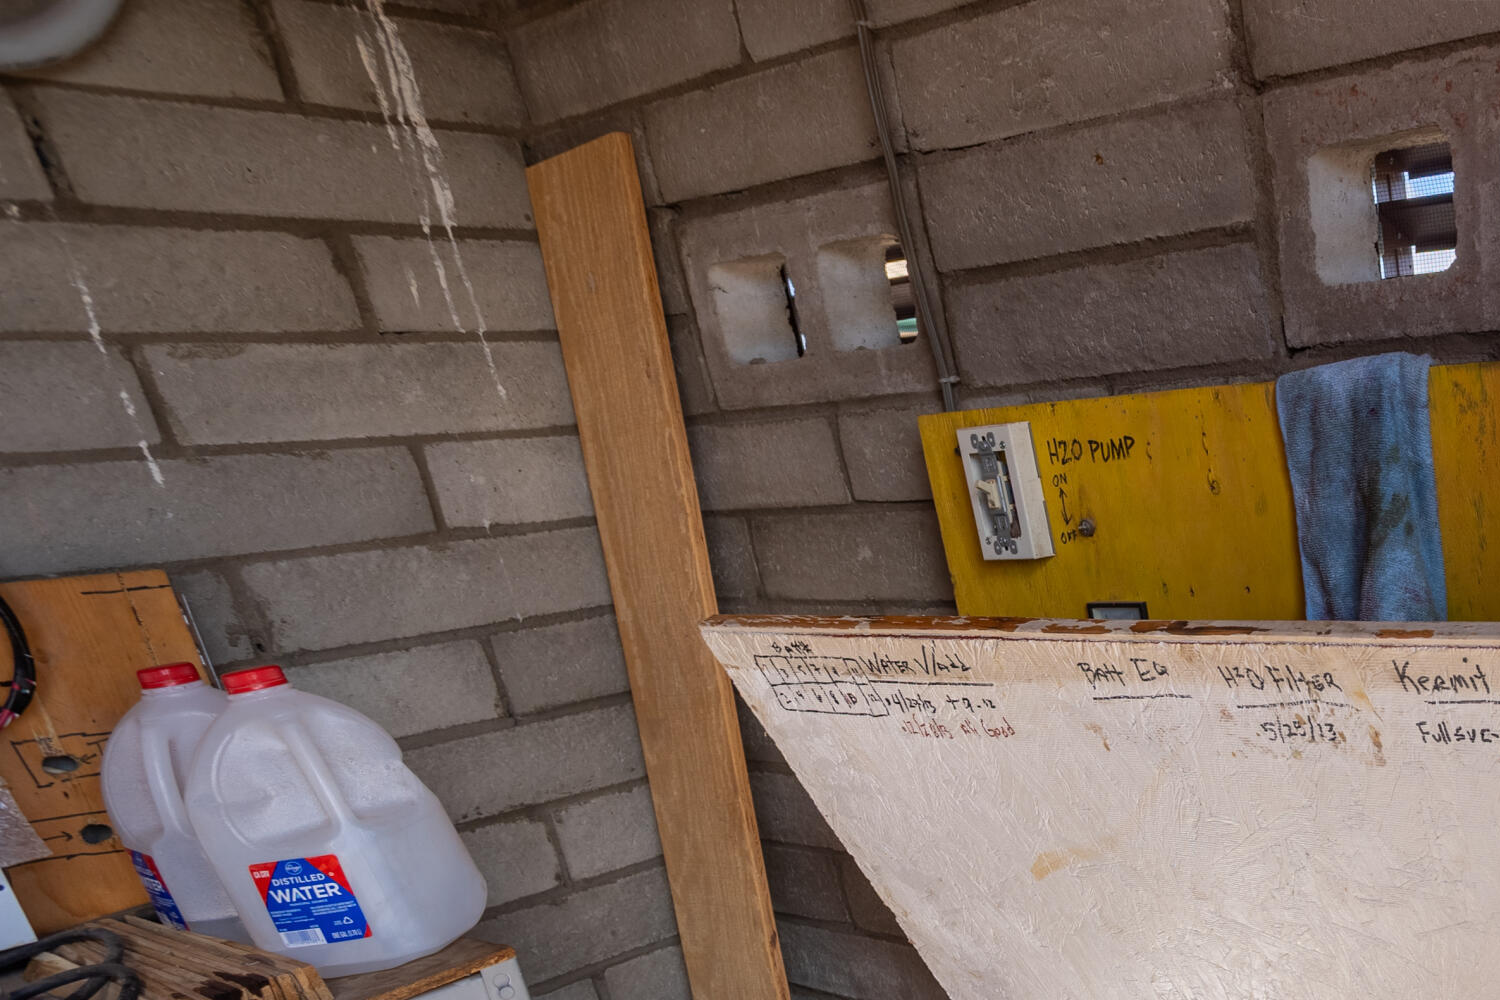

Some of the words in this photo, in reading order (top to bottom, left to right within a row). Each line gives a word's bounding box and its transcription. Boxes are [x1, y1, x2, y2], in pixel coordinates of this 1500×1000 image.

[1047, 438, 1082, 464] H2O
[1089, 436, 1135, 463] PUMP
[1052, 473, 1067, 487] ON
[1061, 530, 1078, 544] OFF
[271, 872, 325, 886] DISTILLED
[268, 882, 342, 903] WATER
